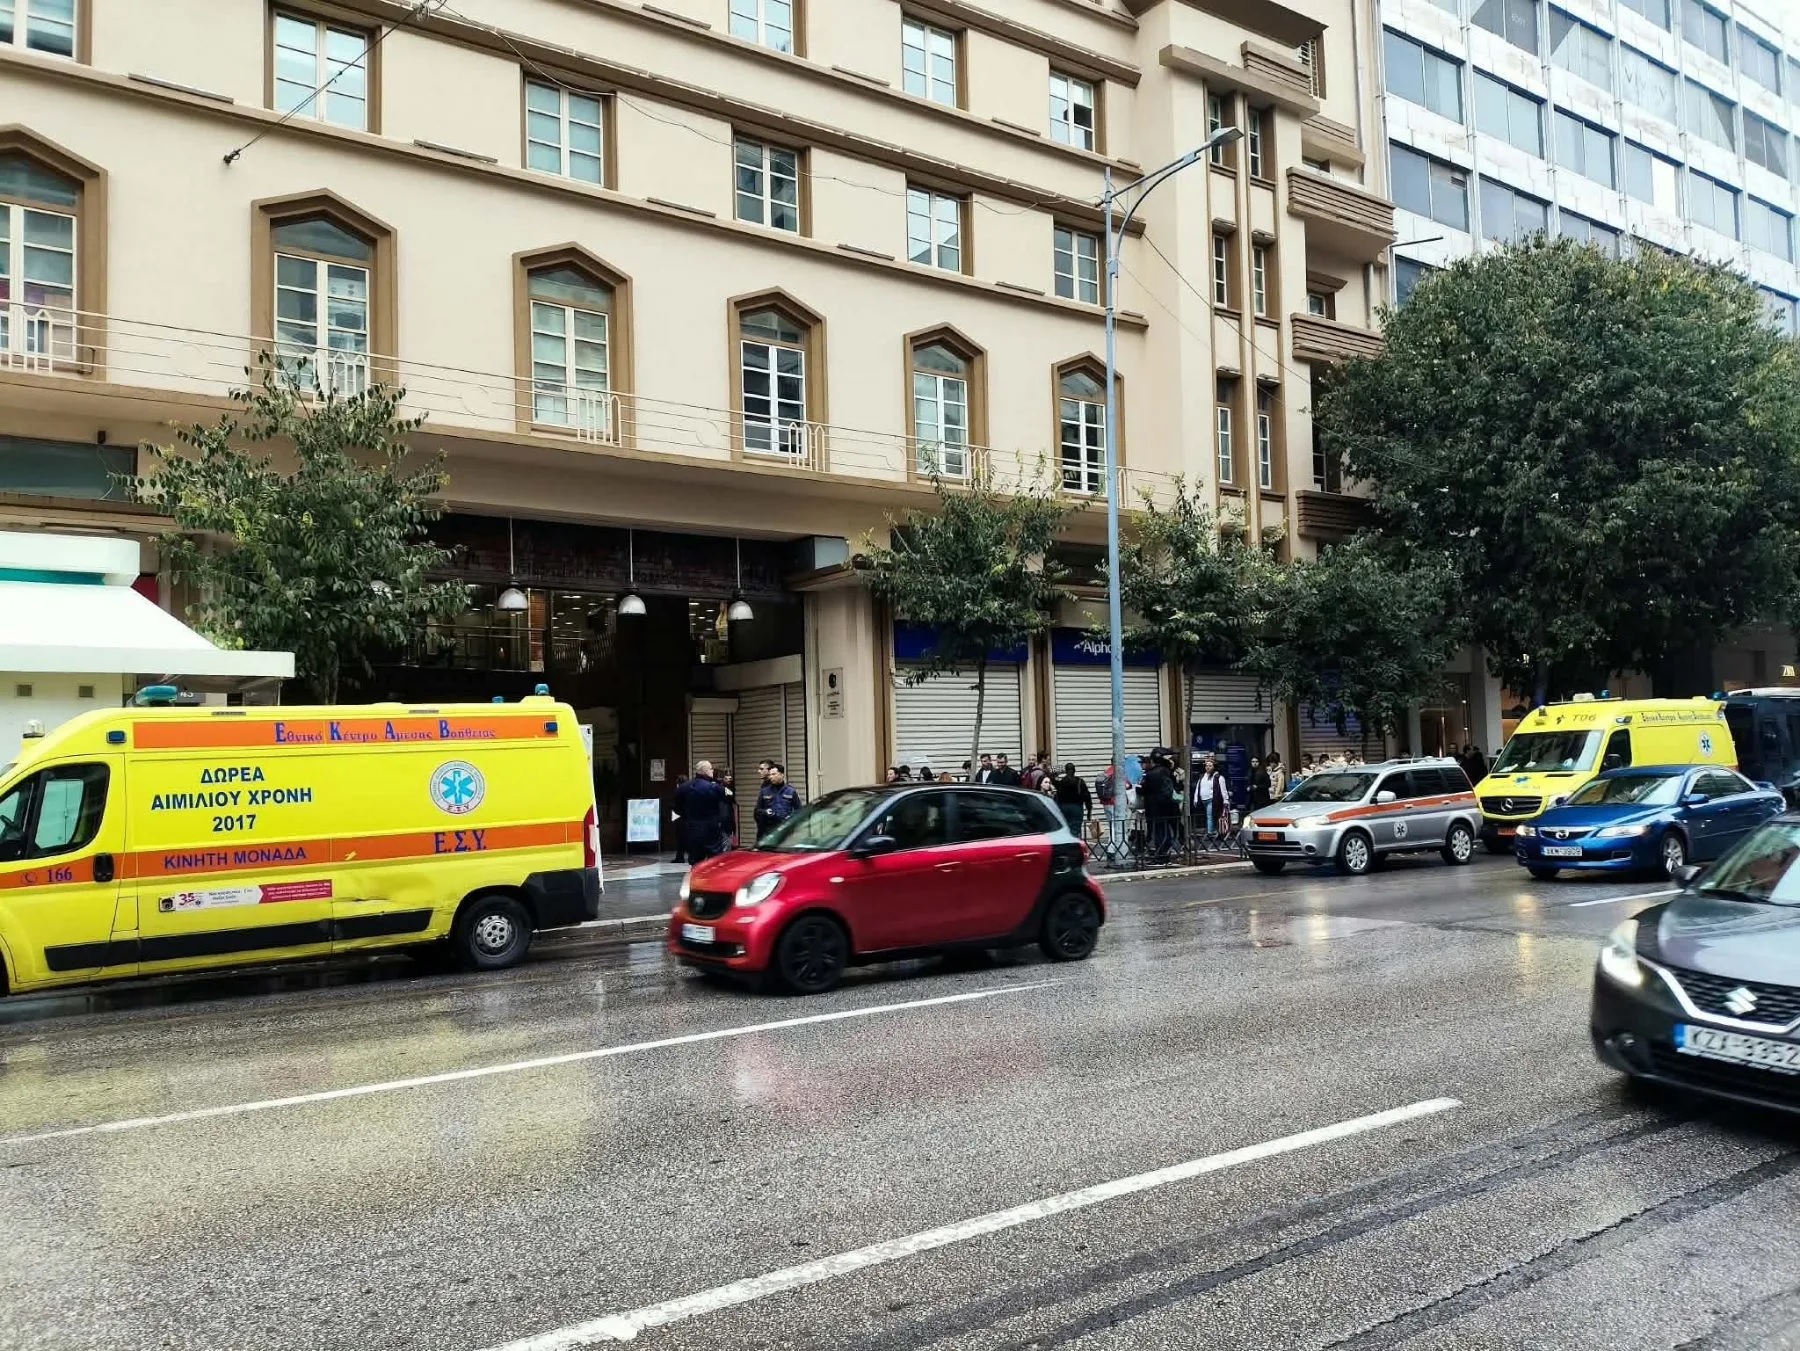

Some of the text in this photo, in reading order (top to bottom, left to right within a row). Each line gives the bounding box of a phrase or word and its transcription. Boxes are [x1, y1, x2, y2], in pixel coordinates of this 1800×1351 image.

[200, 766, 265, 784] ΔΩΡΕΑ
[151, 787, 313, 811] ΑΙΜΙΛΙΟΥ ΧΡΟΝΗ
[212, 814, 257, 832] 2017
[434, 829, 487, 854] Ε.Σ.Υ.
[164, 846, 307, 869] ΚΙΝΗΤΗ ΜΟΝΑΔΑ
[47, 867, 73, 883] 166
